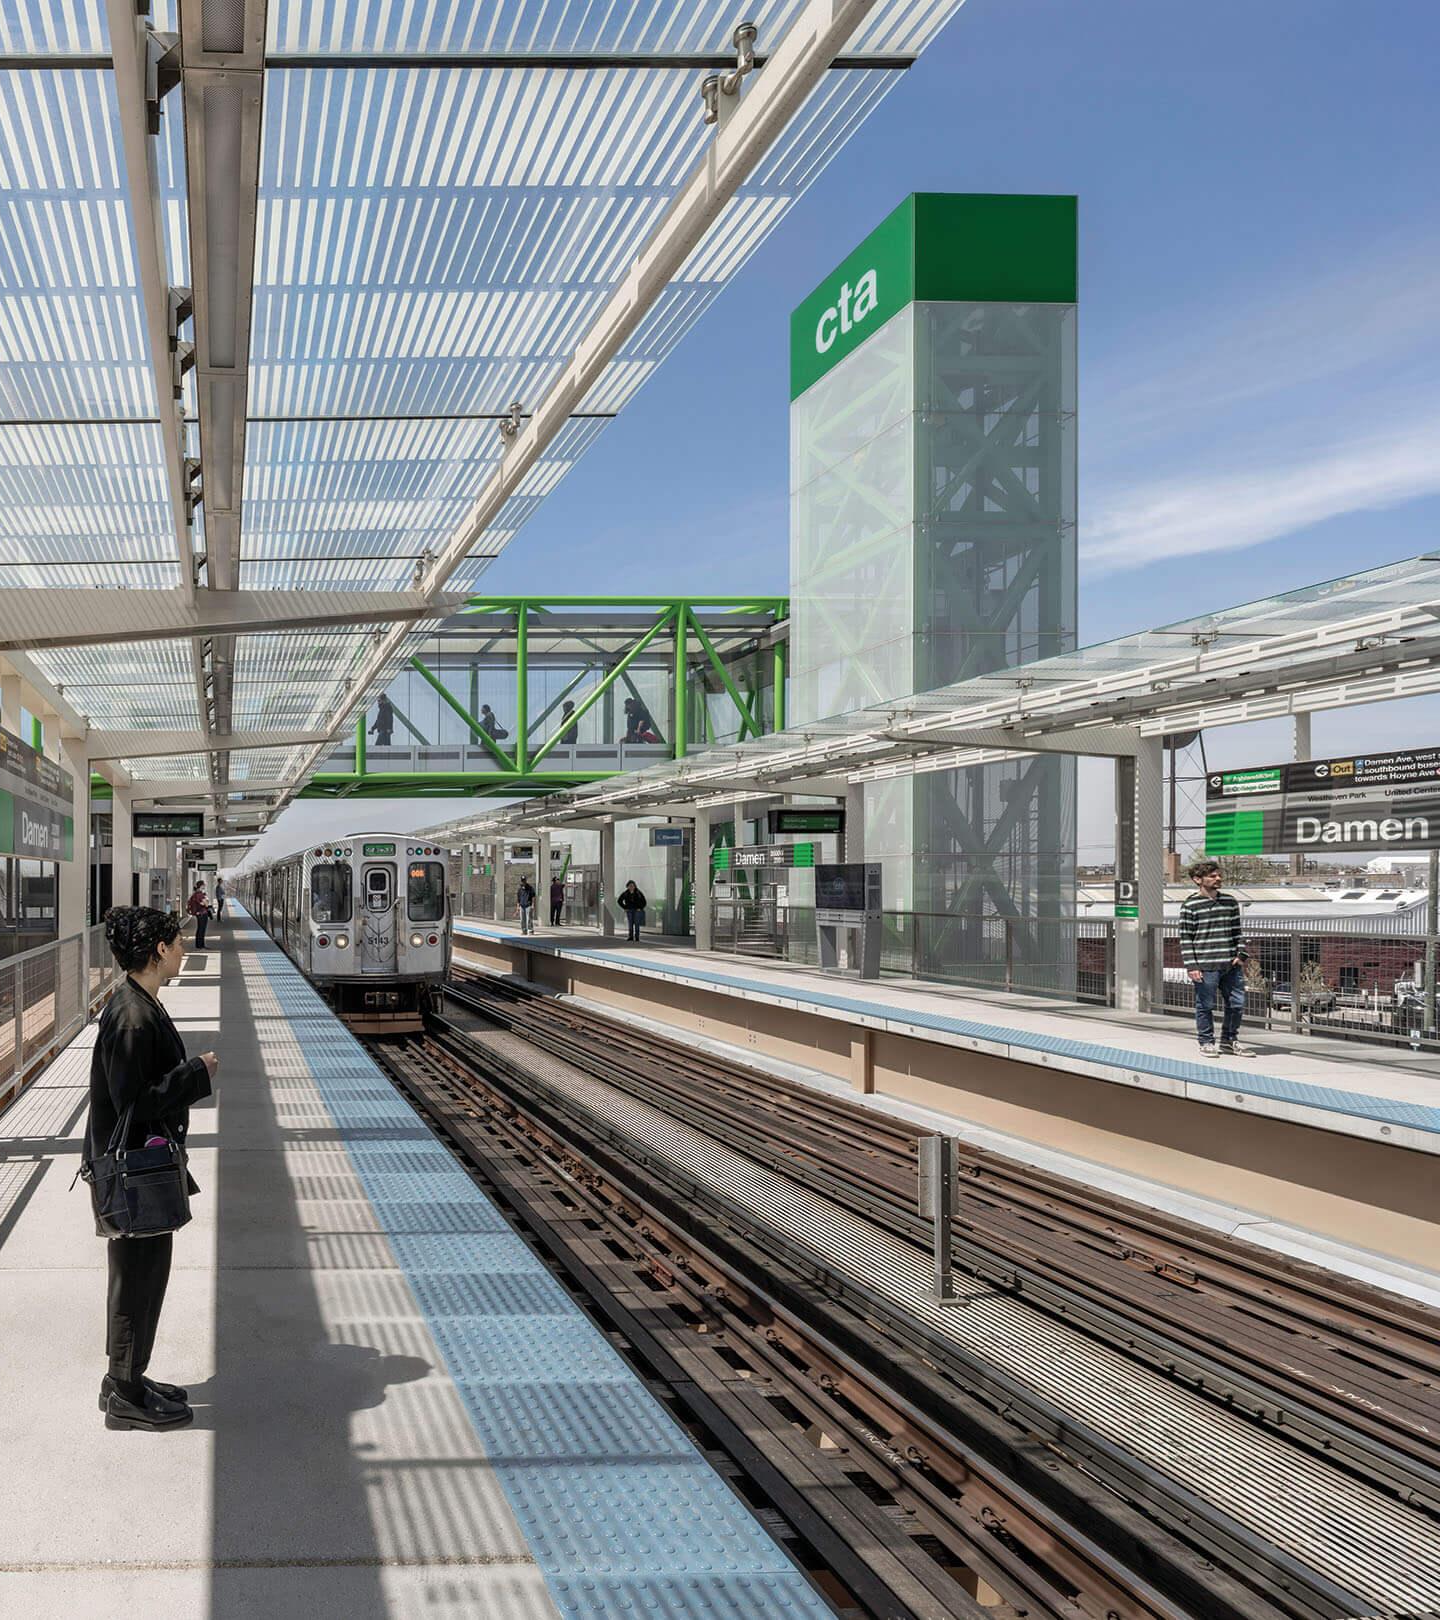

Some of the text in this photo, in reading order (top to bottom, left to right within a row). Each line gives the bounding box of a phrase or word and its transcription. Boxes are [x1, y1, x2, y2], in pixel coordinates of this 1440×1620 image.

[815, 269, 879, 354] cta
[1364, 758, 1394, 766] Damen
[1395, 755, 1414, 764] Ave,
[1415, 753, 1436, 761] west
[1333, 764, 1351, 774] Out
[1364, 763, 1416, 775] southbound
[1355, 769, 1436, 783] towards Hoyne Ave
[1348, 791, 1367, 801] Park
[1385, 787, 1412, 797] United
[22, 811, 49, 848] Damen
[1296, 816, 1429, 844] Damen
[735, 852, 765, 865] Damen
[1119, 882, 1133, 899] D
[368, 937, 389, 945] 5143
